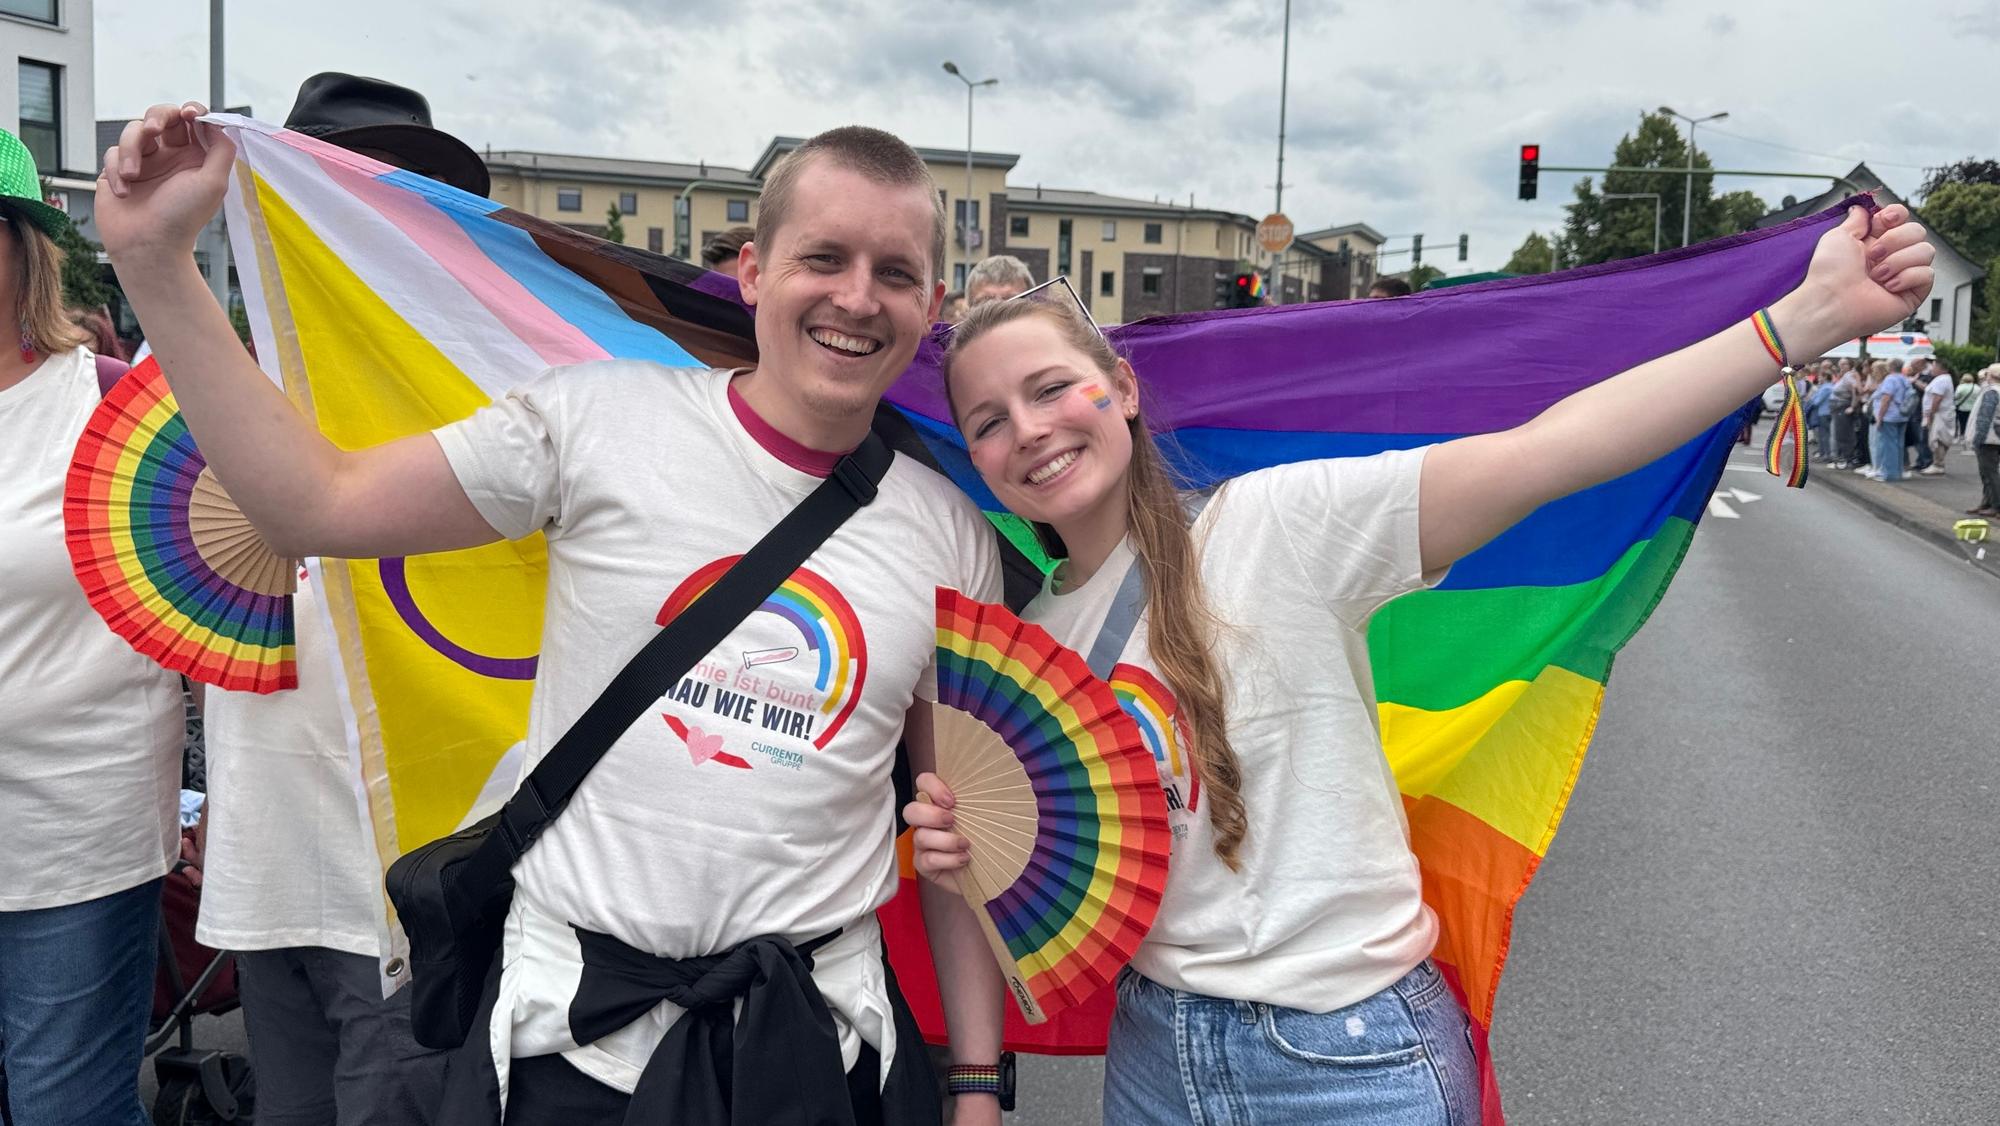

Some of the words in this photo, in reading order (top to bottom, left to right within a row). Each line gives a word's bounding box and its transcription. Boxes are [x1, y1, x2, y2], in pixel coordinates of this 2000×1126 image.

[1259, 224, 1291, 241] STOP
[733, 666, 761, 694] ist
[766, 680, 818, 712] bunt.
[713, 688, 757, 725] WIE
[761, 703, 815, 740] WIR!
[751, 741, 803, 764] CURRENTA
[770, 756, 801, 771] GRUPPE
[1163, 783, 1185, 812] R!
